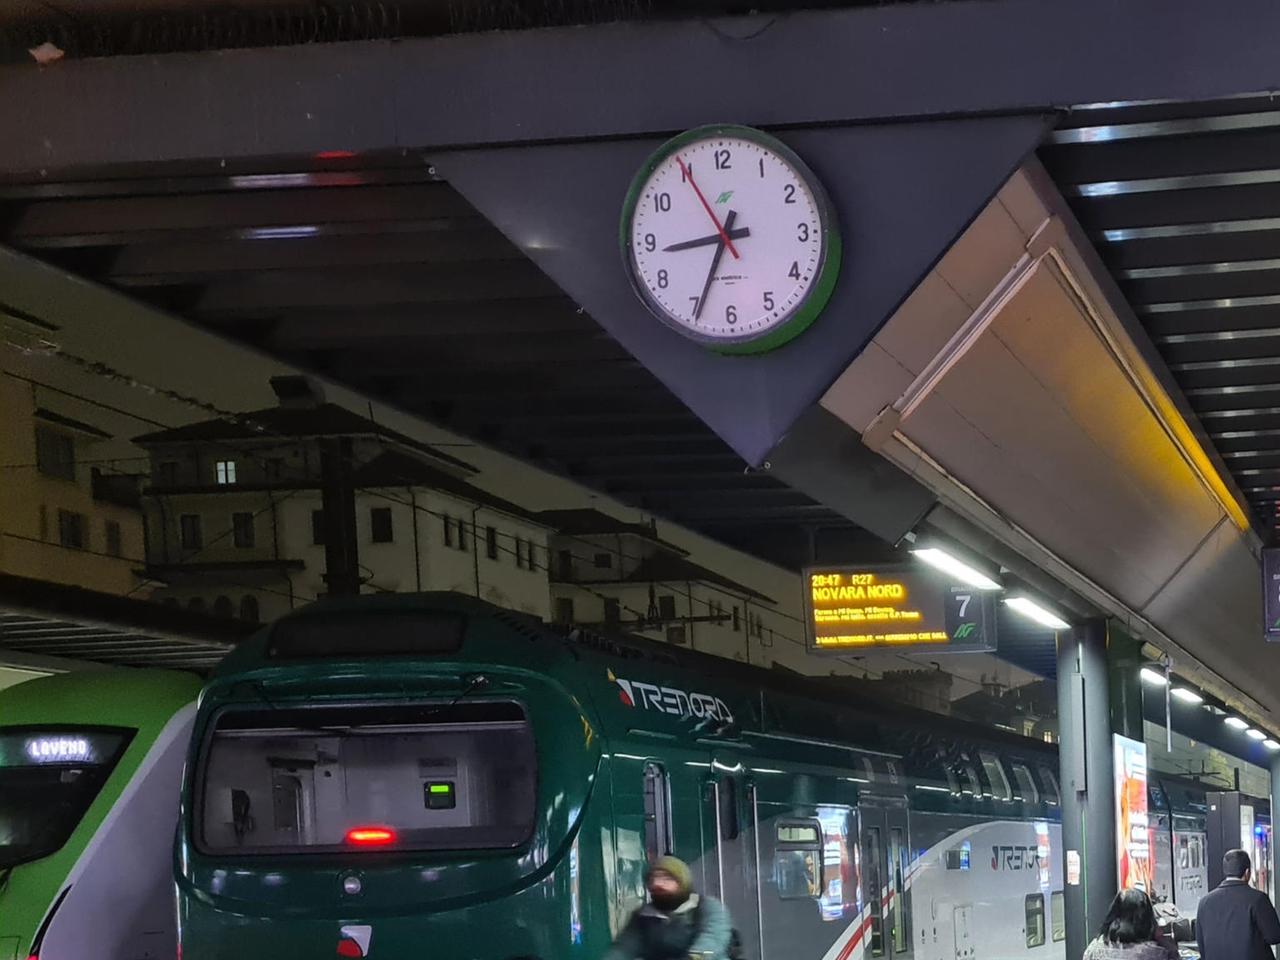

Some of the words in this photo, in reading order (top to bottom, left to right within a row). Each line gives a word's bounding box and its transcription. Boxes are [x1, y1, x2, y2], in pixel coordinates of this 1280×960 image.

[714, 150, 732, 170] 12
[759, 158, 765, 178] 1
[654, 193, 671, 212] 10
[784, 184, 796, 204] 2
[645, 233, 656, 252] 9
[798, 223, 809, 242] 3
[657, 269, 669, 289] 8
[788, 261, 801, 281] 4
[689, 296, 700, 316] 7
[763, 292, 775, 311] 5
[725, 305, 738, 324] 6
[852, 574, 873, 585] R27
[812, 586, 866, 600] NOVARA
[867, 584, 903, 598] NORD
[955, 594, 971, 617] 7
[631, 681, 734, 723] TRENORD
